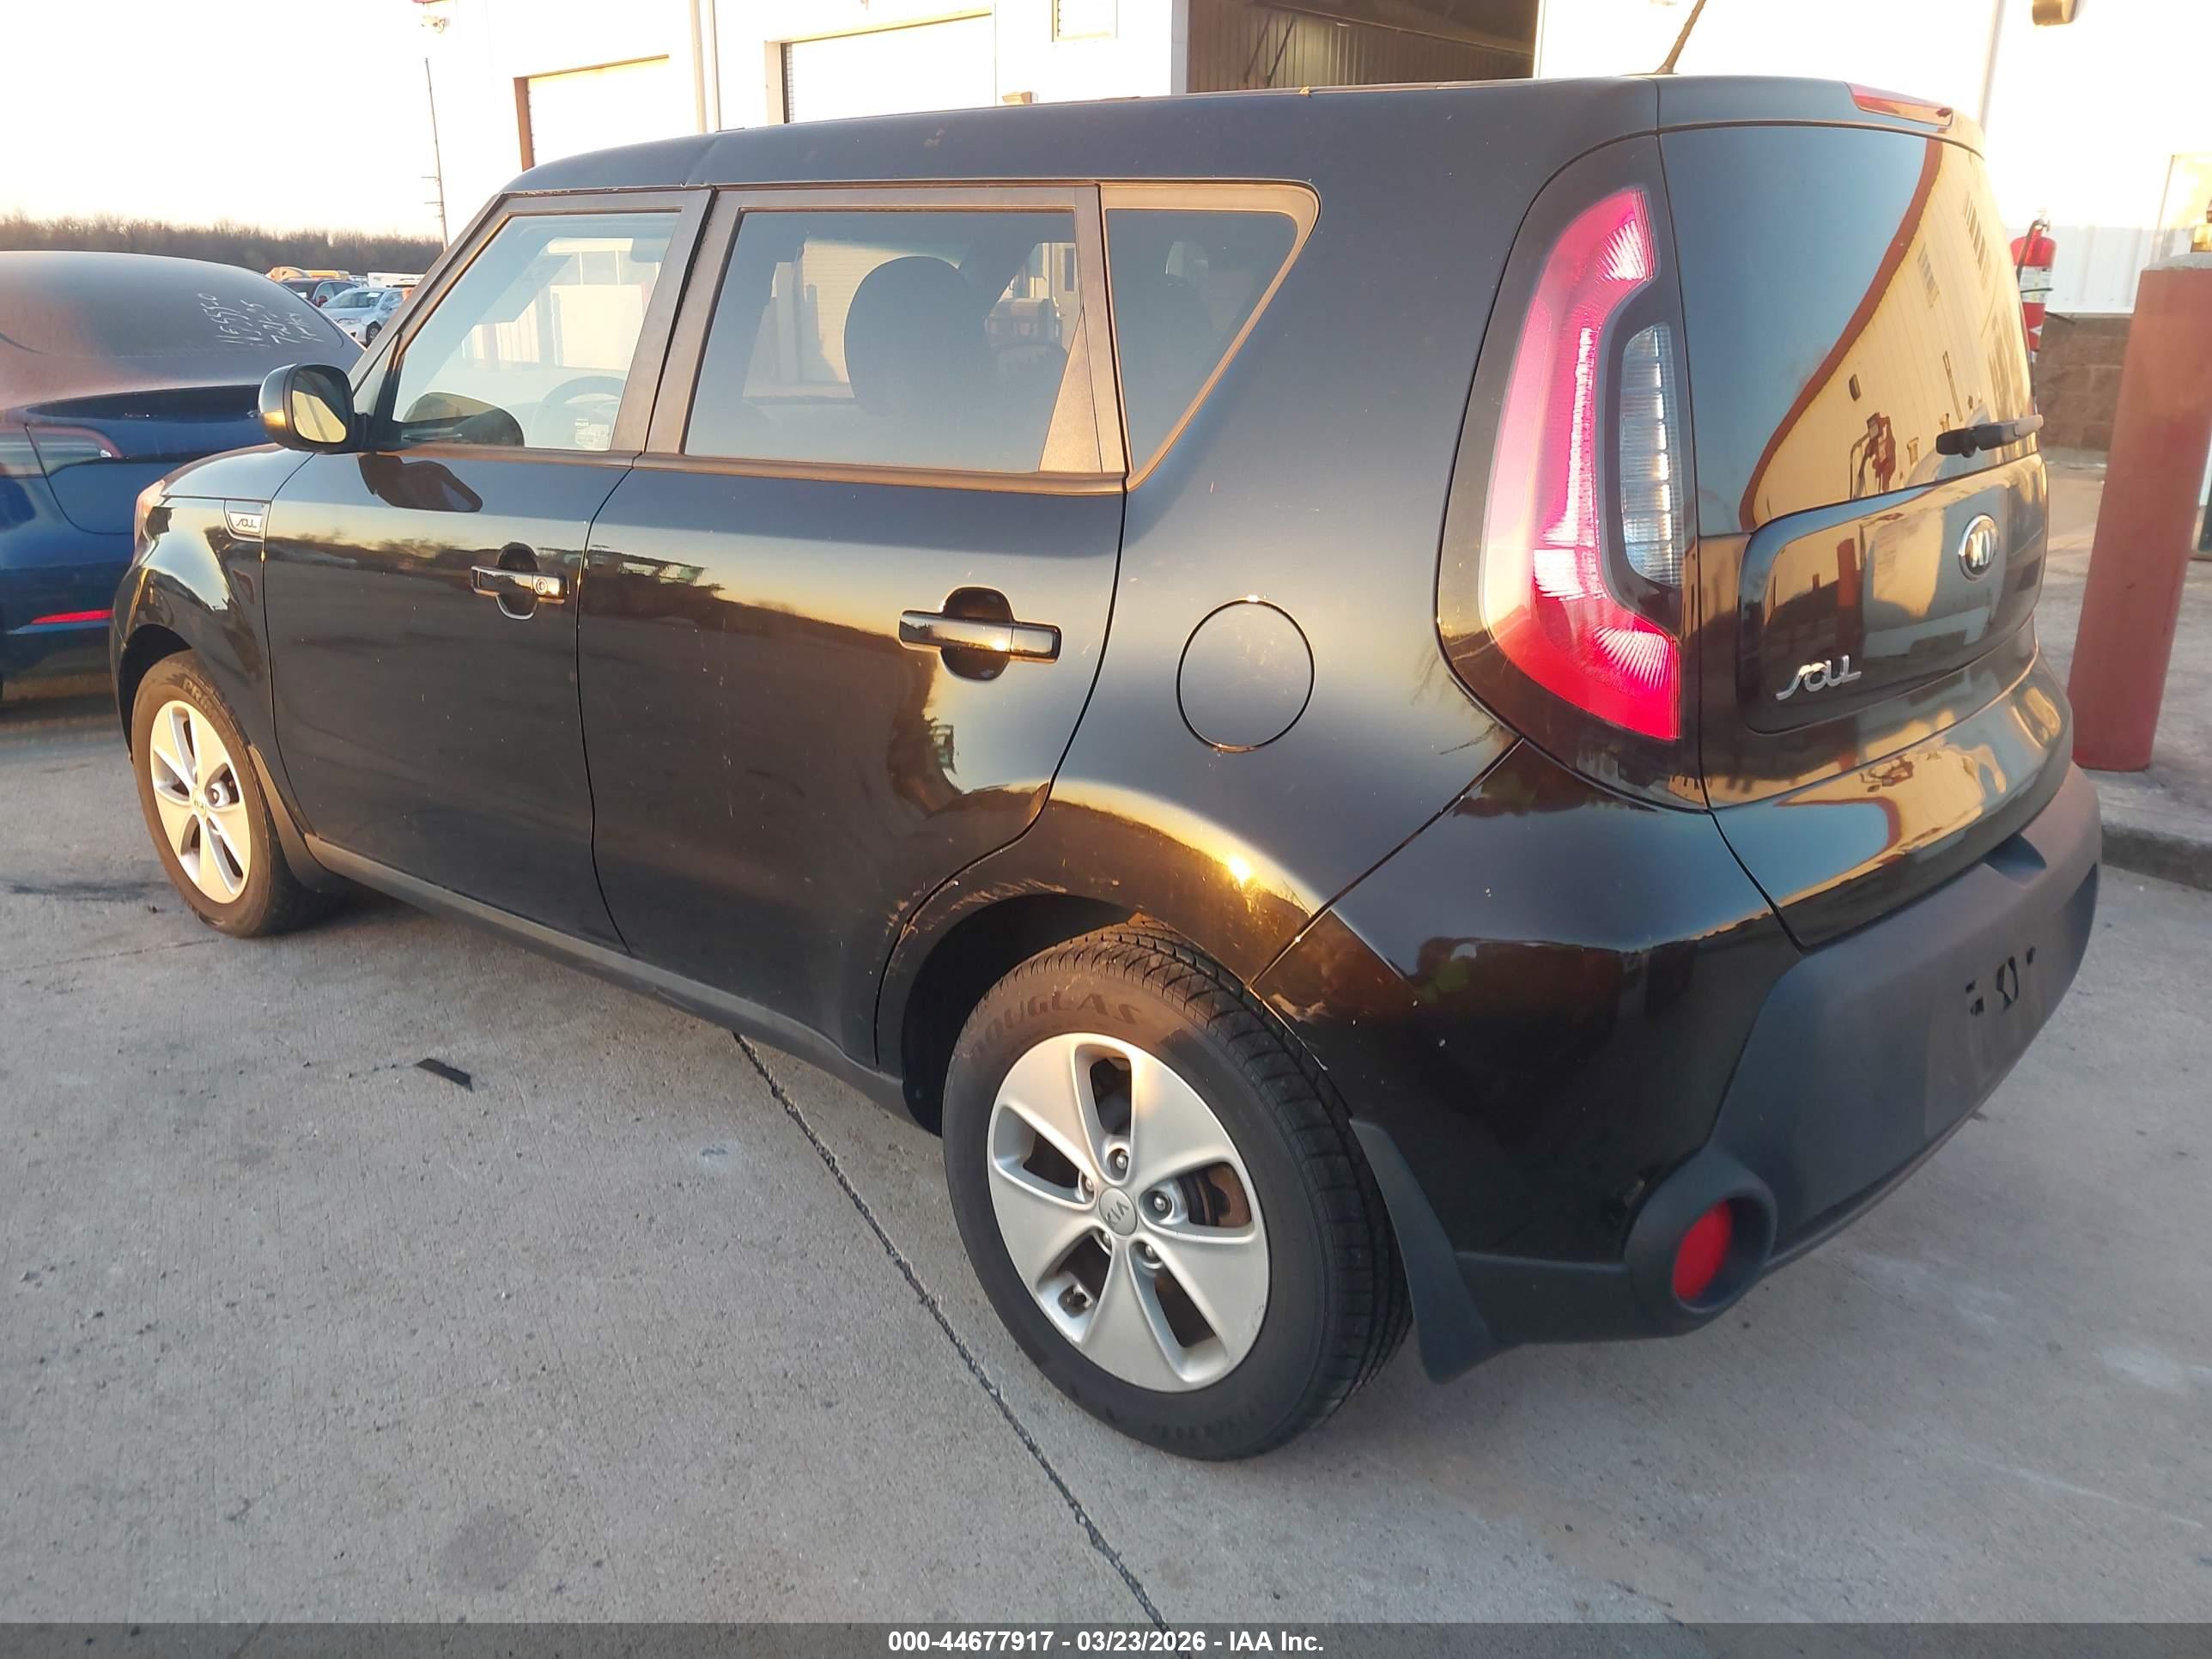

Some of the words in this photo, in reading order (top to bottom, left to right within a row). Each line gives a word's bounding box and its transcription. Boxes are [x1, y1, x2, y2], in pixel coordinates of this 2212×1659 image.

[1970, 527, 1999, 568] KIA
[1775, 654, 1863, 701] SOUL
[1104, 1200, 1130, 1231] KIA
